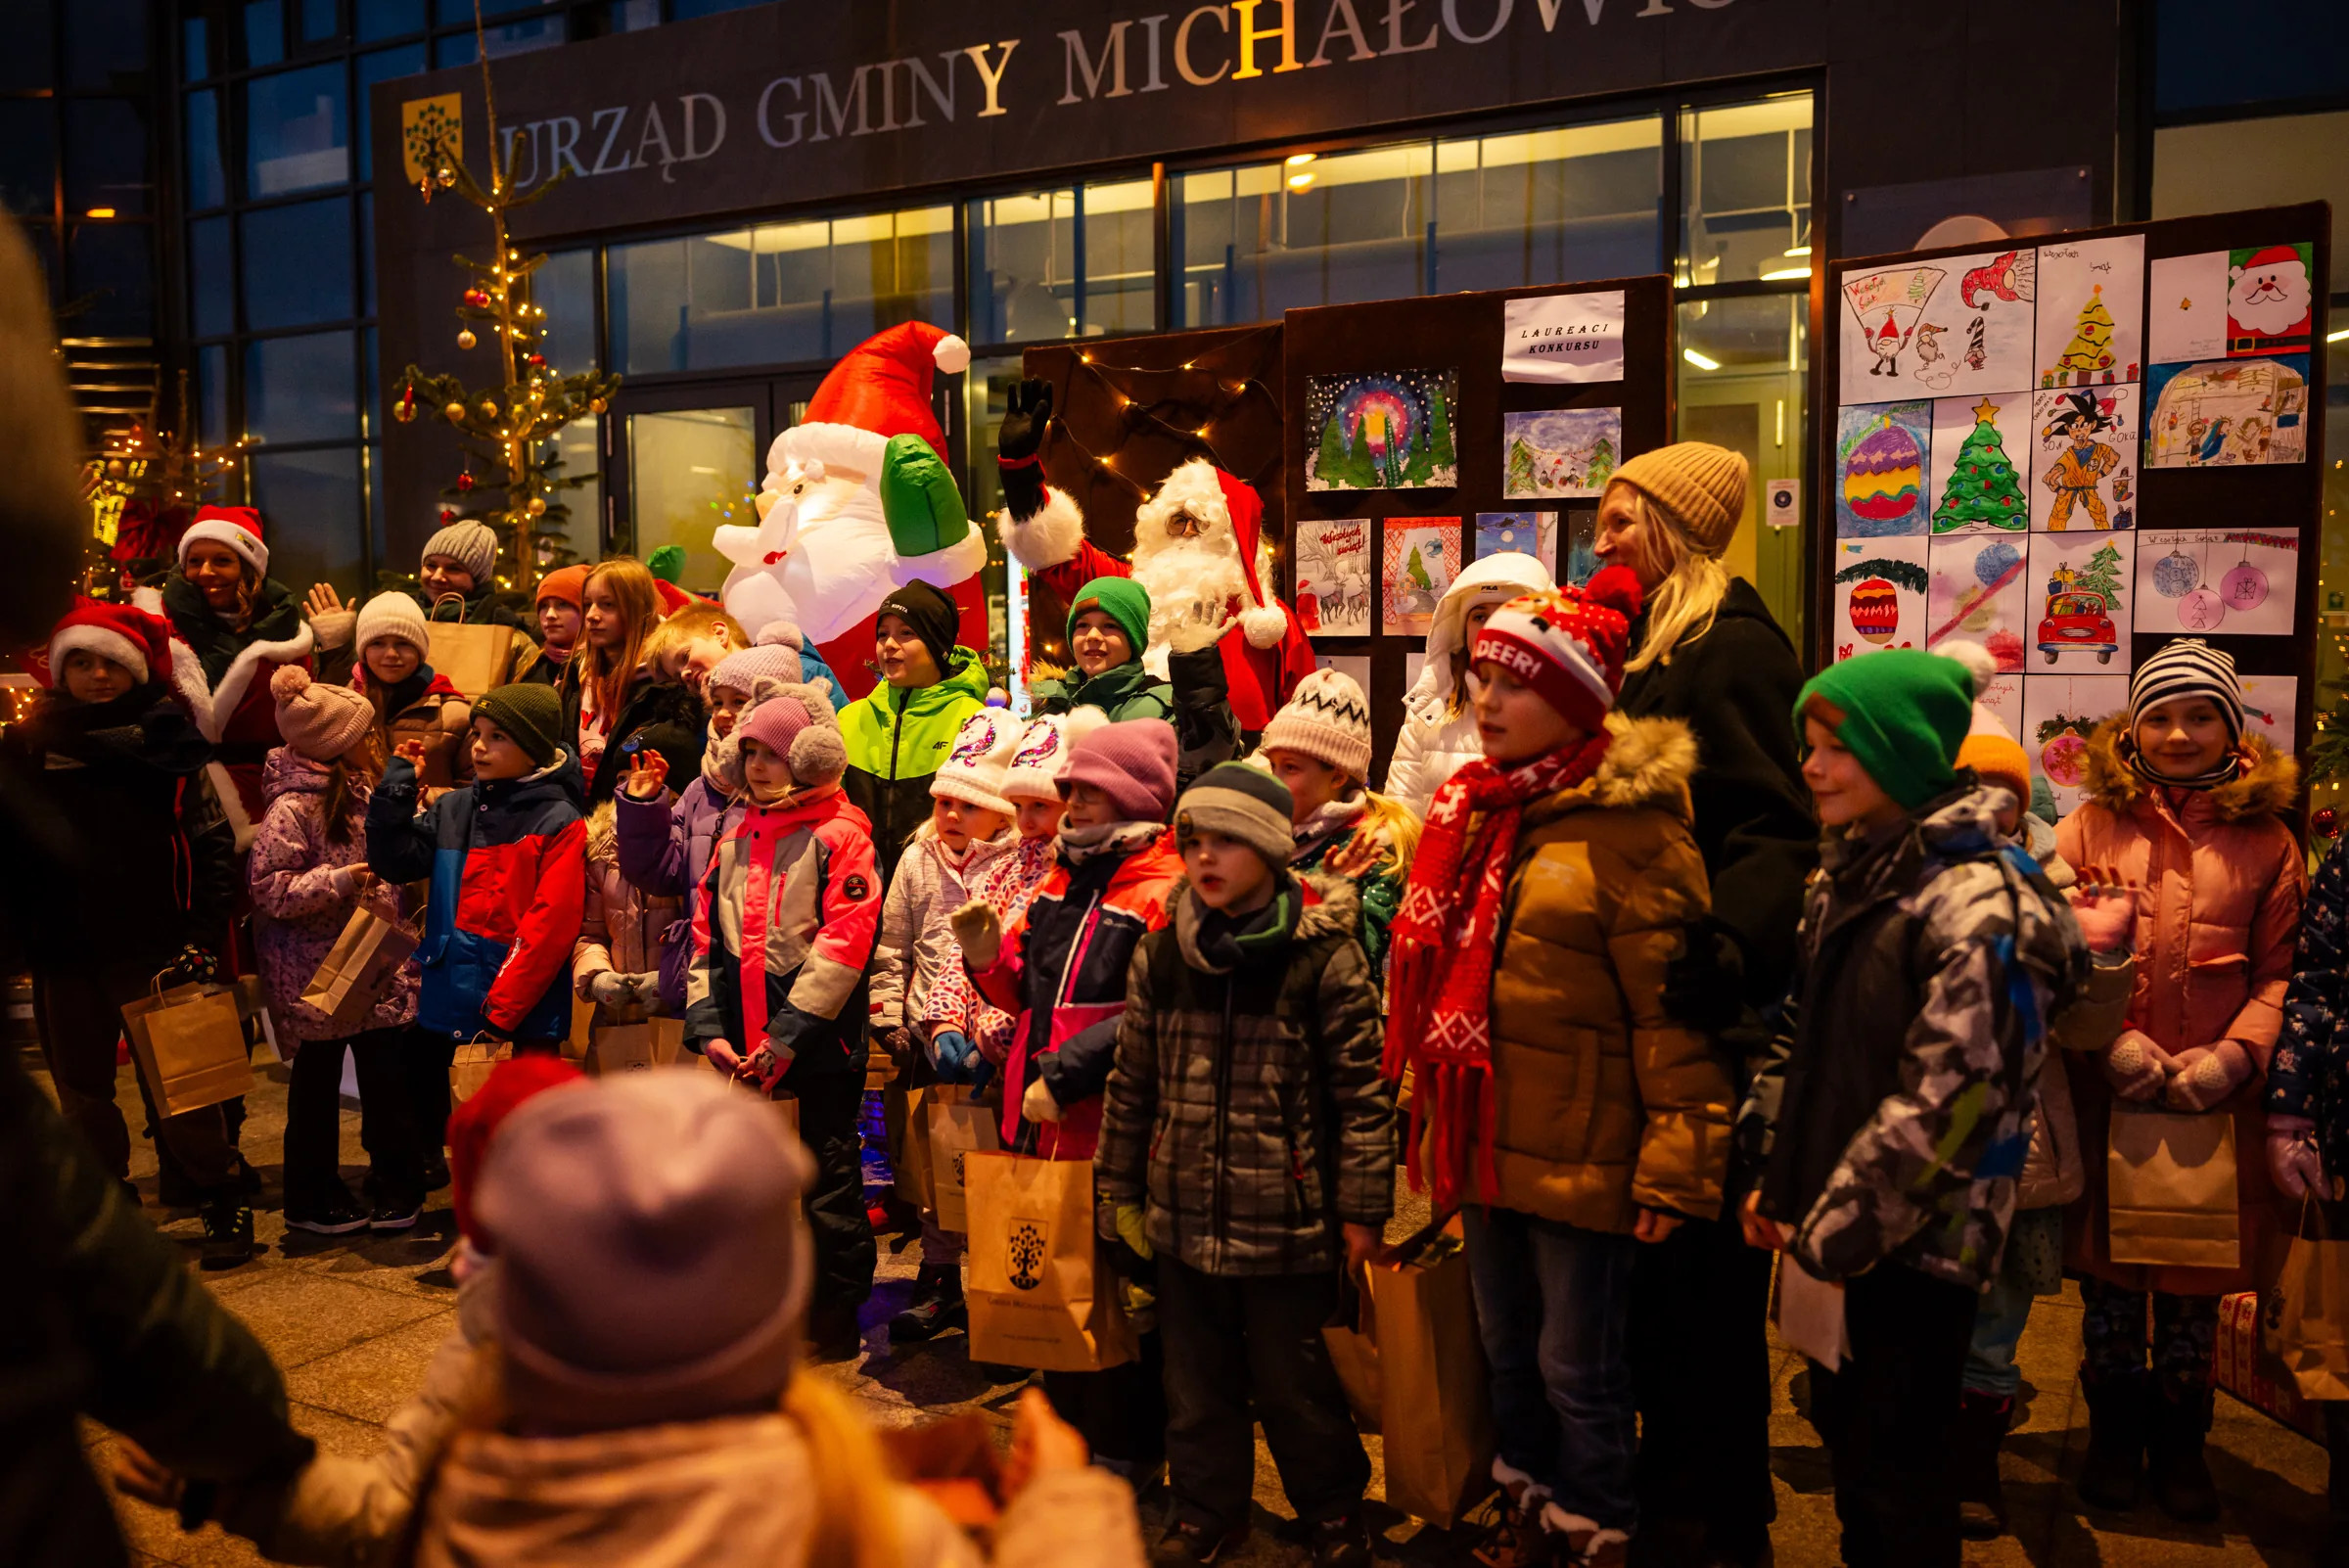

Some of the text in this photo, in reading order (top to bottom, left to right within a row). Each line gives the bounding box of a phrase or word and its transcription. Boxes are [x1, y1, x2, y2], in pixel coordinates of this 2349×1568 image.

[498, 0, 1735, 188] URZĄD GMINY MICHAŁO
[1521, 323, 1608, 339] LAUREACI
[1528, 340, 1599, 354] KONKURSU
[2043, 439, 2062, 452] SON
[1475, 639, 1543, 679] DEER!
[932, 741, 949, 750] 4F
